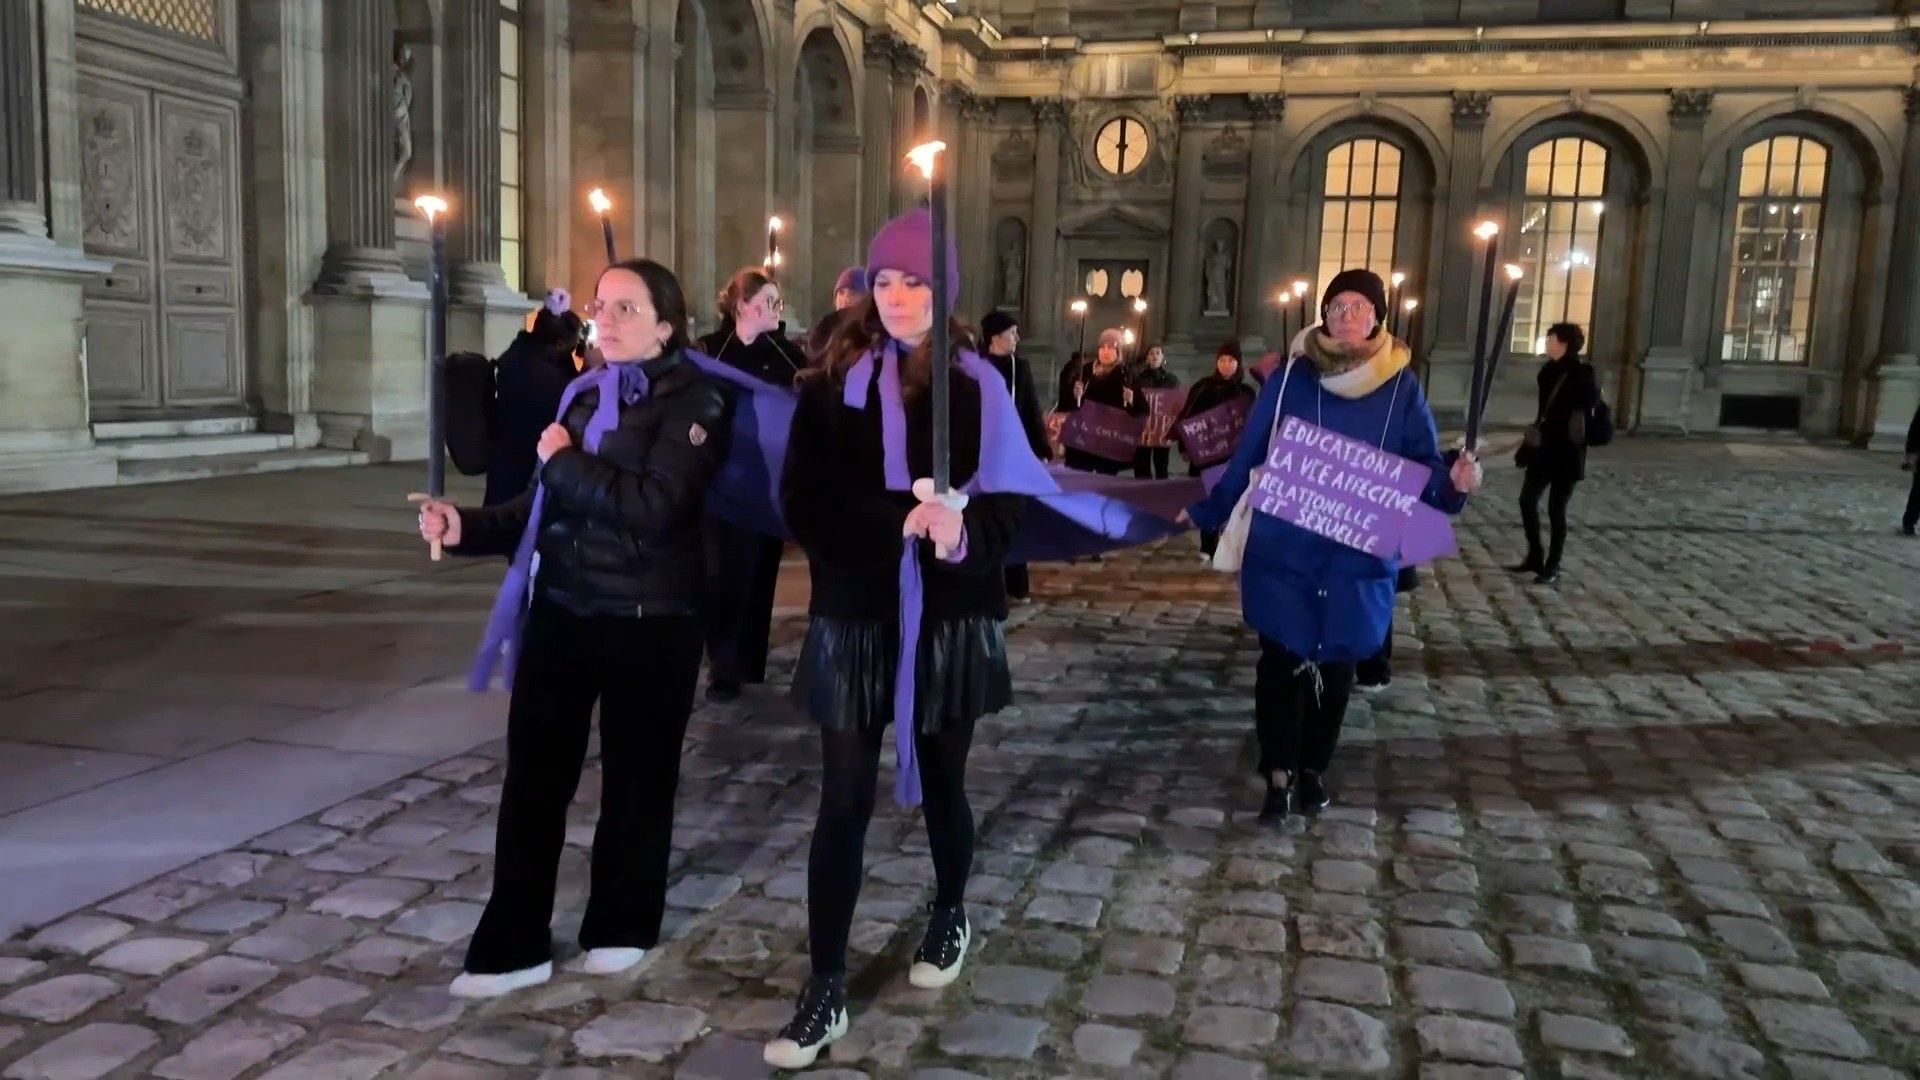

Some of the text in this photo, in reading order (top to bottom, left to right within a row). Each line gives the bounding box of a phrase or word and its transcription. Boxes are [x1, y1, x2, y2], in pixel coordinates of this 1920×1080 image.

[1269, 446, 1293, 473] LA
[1300, 455, 1333, 487] VIE
[1259, 471, 1379, 531] RELATIONELLE
[1261, 496, 1379, 554] ET SEXUELLE
